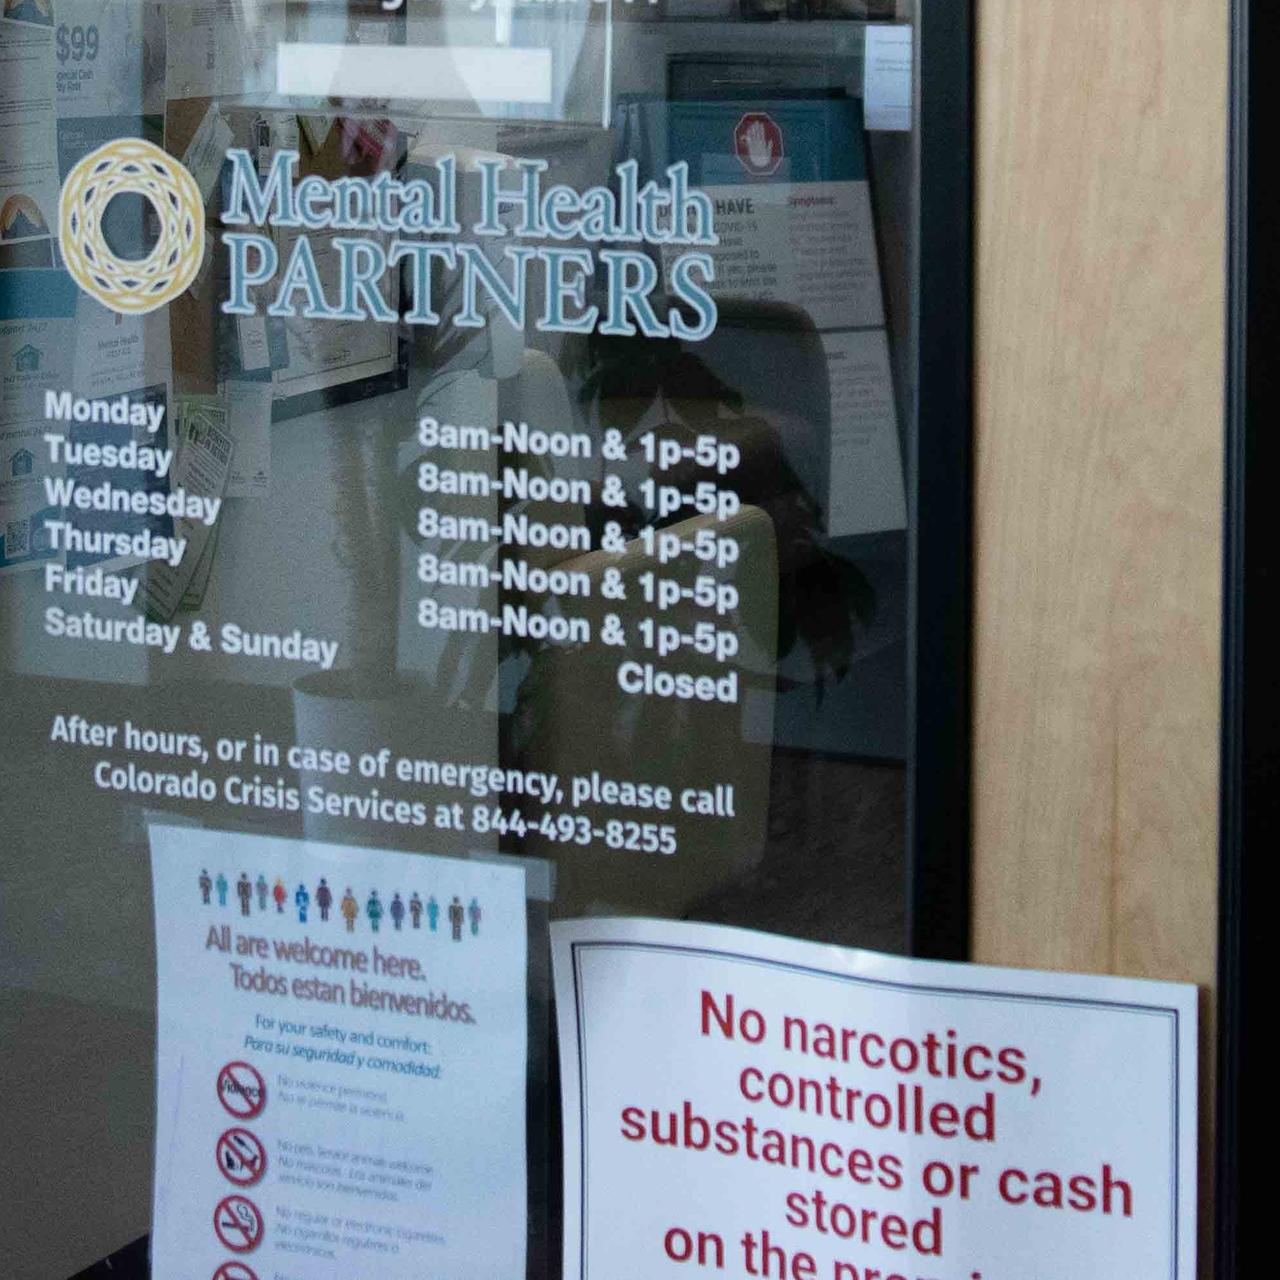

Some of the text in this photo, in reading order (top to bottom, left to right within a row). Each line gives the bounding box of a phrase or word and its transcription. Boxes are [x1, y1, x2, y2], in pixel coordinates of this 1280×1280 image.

[221, 148, 718, 246] Mental Health
[715, 197, 755, 215] HAVE
[221, 234, 718, 342] PARTNERS
[44, 390, 166, 434] Monday
[417, 416, 592, 459] 8am-Noon
[601, 428, 628, 461] &
[639, 433, 742, 476] 1p-5p
[44, 434, 173, 478] Tuesday
[417, 462, 592, 505] 8am-Noon
[601, 474, 628, 508] &
[638, 478, 741, 522] 1p-5p
[44, 477, 740, 569] Wednesday 8am-Noon & 1p-5p
[44, 521, 740, 616] Thursday 8am-Noon & 1p-5p
[44, 563, 739, 663] Friday 8am-Noon & 1p-5p
[44, 606, 739, 704] Saturday & Sunday Closed
[51, 715, 736, 818] After hours, or in case of emergency, please call
[93, 760, 678, 855] Colorado Crisis Services at 844-493-8255
[205, 924, 427, 982] All are welcome here.
[230, 962, 478, 1026] Todos estan bienvenidos.
[244, 1035, 273, 1054] Para
[275, 1041, 291, 1056] su
[292, 1041, 356, 1067] seguridad
[356, 1054, 366, 1070] y
[255, 1014, 275, 1031] For
[278, 1020, 307, 1039] your
[310, 1022, 347, 1044] safety
[349, 1030, 374, 1046] and
[699, 988, 1043, 1098] No narcotics,
[738, 1065, 997, 1142] controlled
[620, 1100, 1133, 1218] substances or cash
[663, 1224, 723, 1269] on
[741, 1228, 818, 1280] the
[784, 1188, 944, 1257] stored
